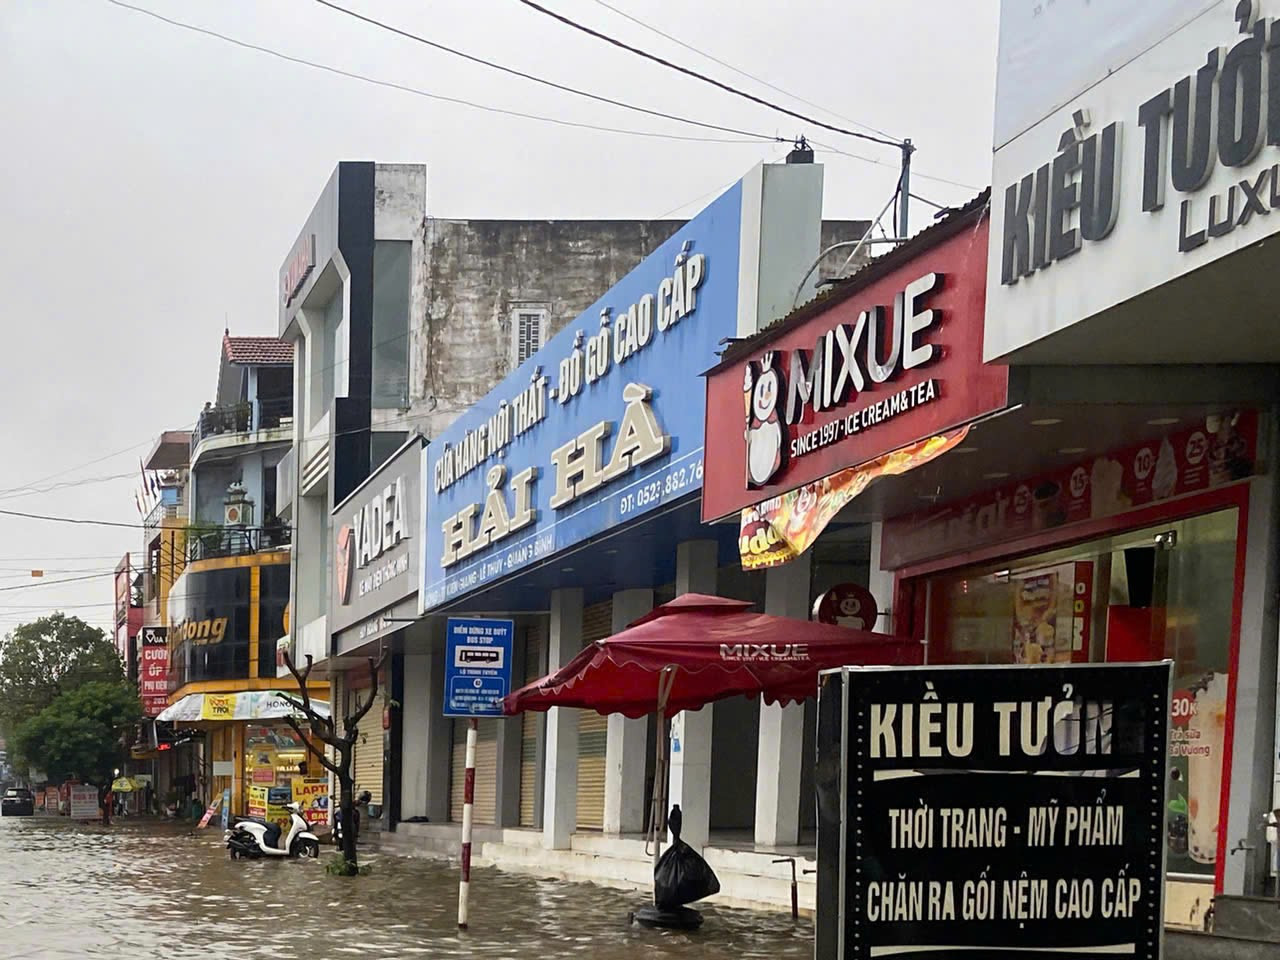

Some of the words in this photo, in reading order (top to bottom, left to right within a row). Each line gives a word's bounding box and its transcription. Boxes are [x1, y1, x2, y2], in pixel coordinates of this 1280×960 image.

[455, 424, 488, 482] HÀNG
[487, 400, 512, 458] NỘI
[513, 366, 549, 437] THẤT
[559, 329, 584, 404] ĐỒ
[585, 307, 612, 385] GỖ
[614, 294, 653, 364] CAO
[657, 240, 705, 332] CẤP
[785, 272, 943, 425] MIXUE
[790, 429, 819, 458] SINCE
[819, 420, 839, 446] 1997
[844, 411, 860, 435] ICE
[441, 464, 539, 568] HẢI
[550, 383, 672, 510] HÀ
[353, 475, 412, 569] YADEA
[719, 643, 808, 657] MIXUE
[266, 700, 293, 709] HONO
[869, 681, 975, 759] KIỀU
[295, 785, 328, 796] LAPT
[888, 798, 934, 849] THỜI
[940, 806, 1008, 849] TRANG
[1026, 798, 1059, 847] MỸ
[1064, 787, 1124, 846] PHẨM
[866, 873, 923, 922] CHĂN
[927, 880, 956, 921] RA
[962, 865, 996, 921] GỐI
[1002, 871, 1049, 929] NỆM
[1055, 878, 1095, 919] CAO
[1101, 863, 1142, 919] CẤP
